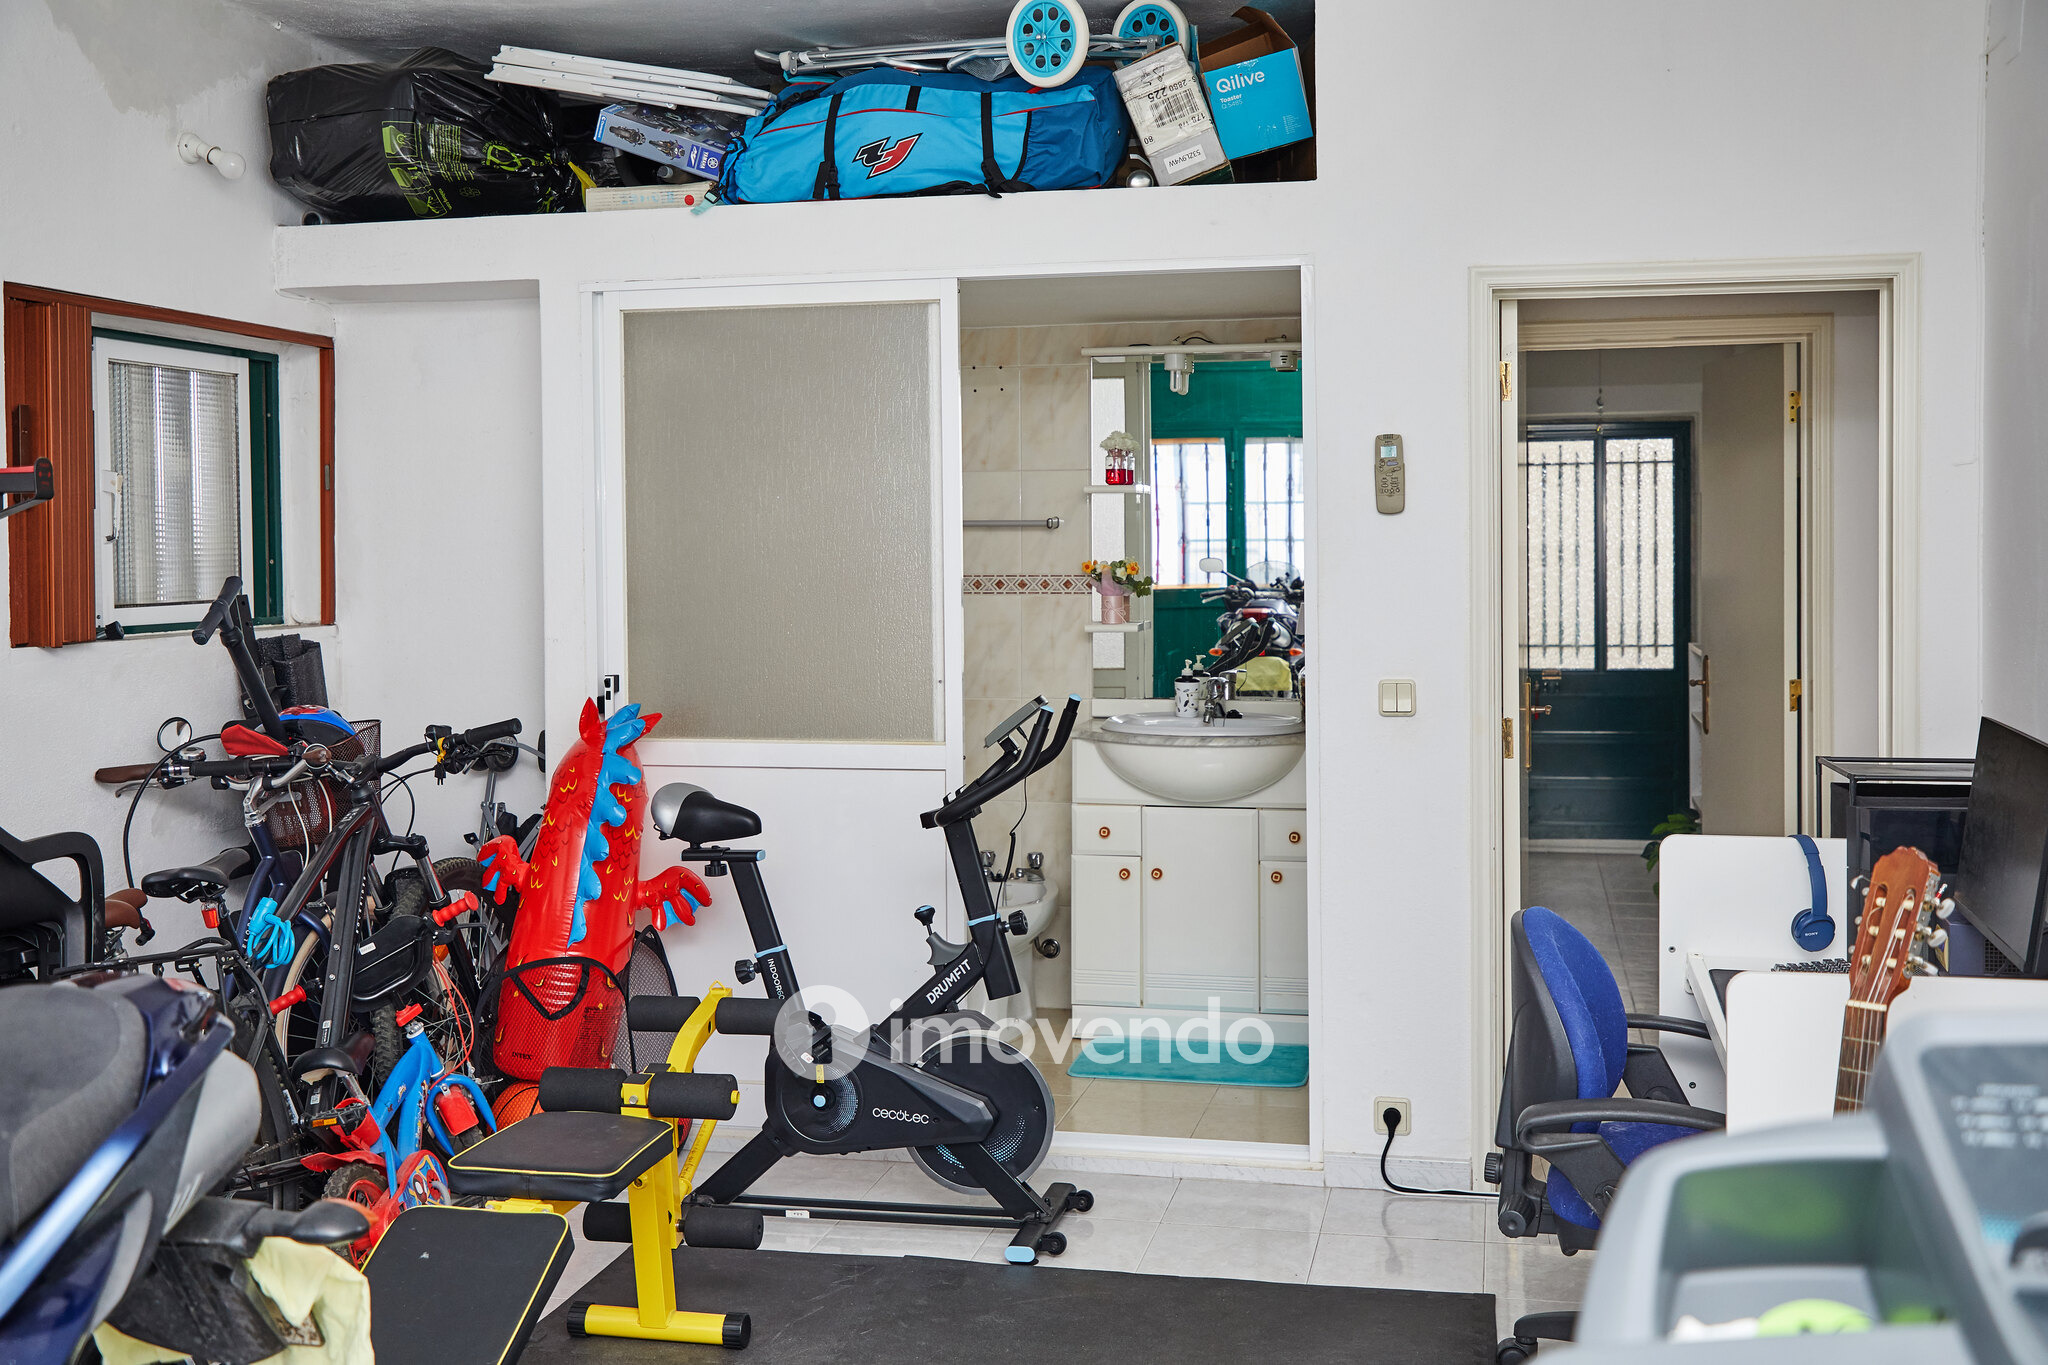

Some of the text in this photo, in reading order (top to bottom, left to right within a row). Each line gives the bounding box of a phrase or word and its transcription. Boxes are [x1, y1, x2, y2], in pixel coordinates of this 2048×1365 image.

[1216, 71, 1265, 93] Qilive
[1147, 86, 1168, 103] 225
[1220, 94, 1242, 104] Toaster
[1143, 135, 1154, 145] 80
[700, 152, 709, 169] YAMAHA
[925, 958, 972, 1004] DRUMFIT
[512, 1051, 533, 1060] INTEX
[872, 1107, 930, 1125] cecotec
